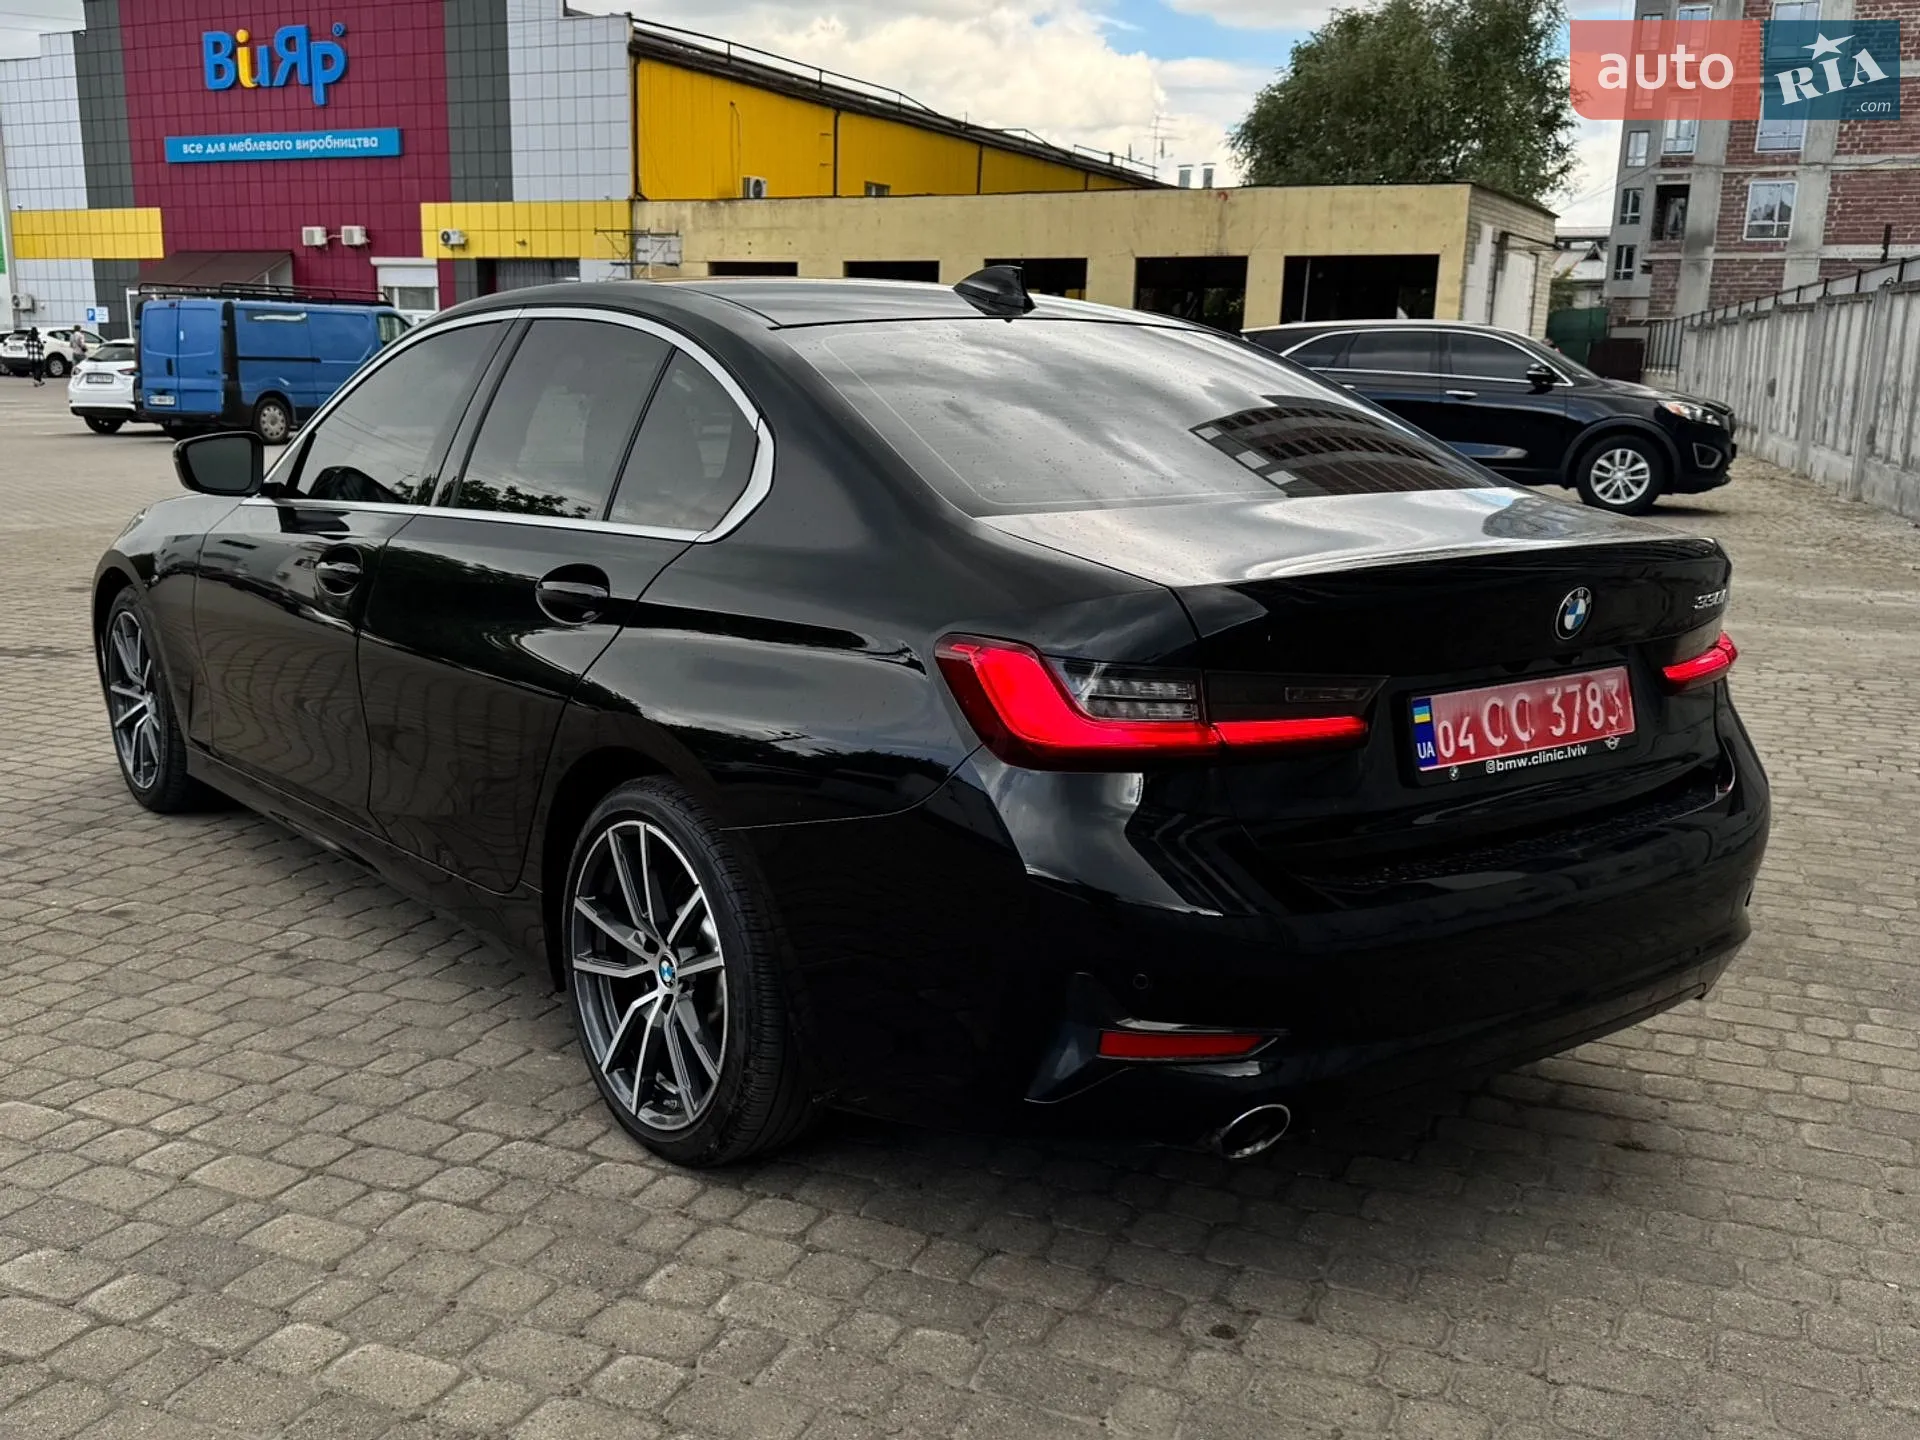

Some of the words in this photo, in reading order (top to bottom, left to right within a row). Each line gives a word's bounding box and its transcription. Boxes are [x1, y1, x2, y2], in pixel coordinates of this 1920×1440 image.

[183, 143, 203, 154] все
[206, 142, 226, 154] для
[228, 138, 293, 153] меблевого
[296, 134, 379, 153] виробництва
[1438, 716, 1475, 758] 04
[1482, 692, 1535, 747] CC
[1417, 742, 1436, 759] UA
[1486, 745, 1588, 774] @bmw.clinic.lviv
